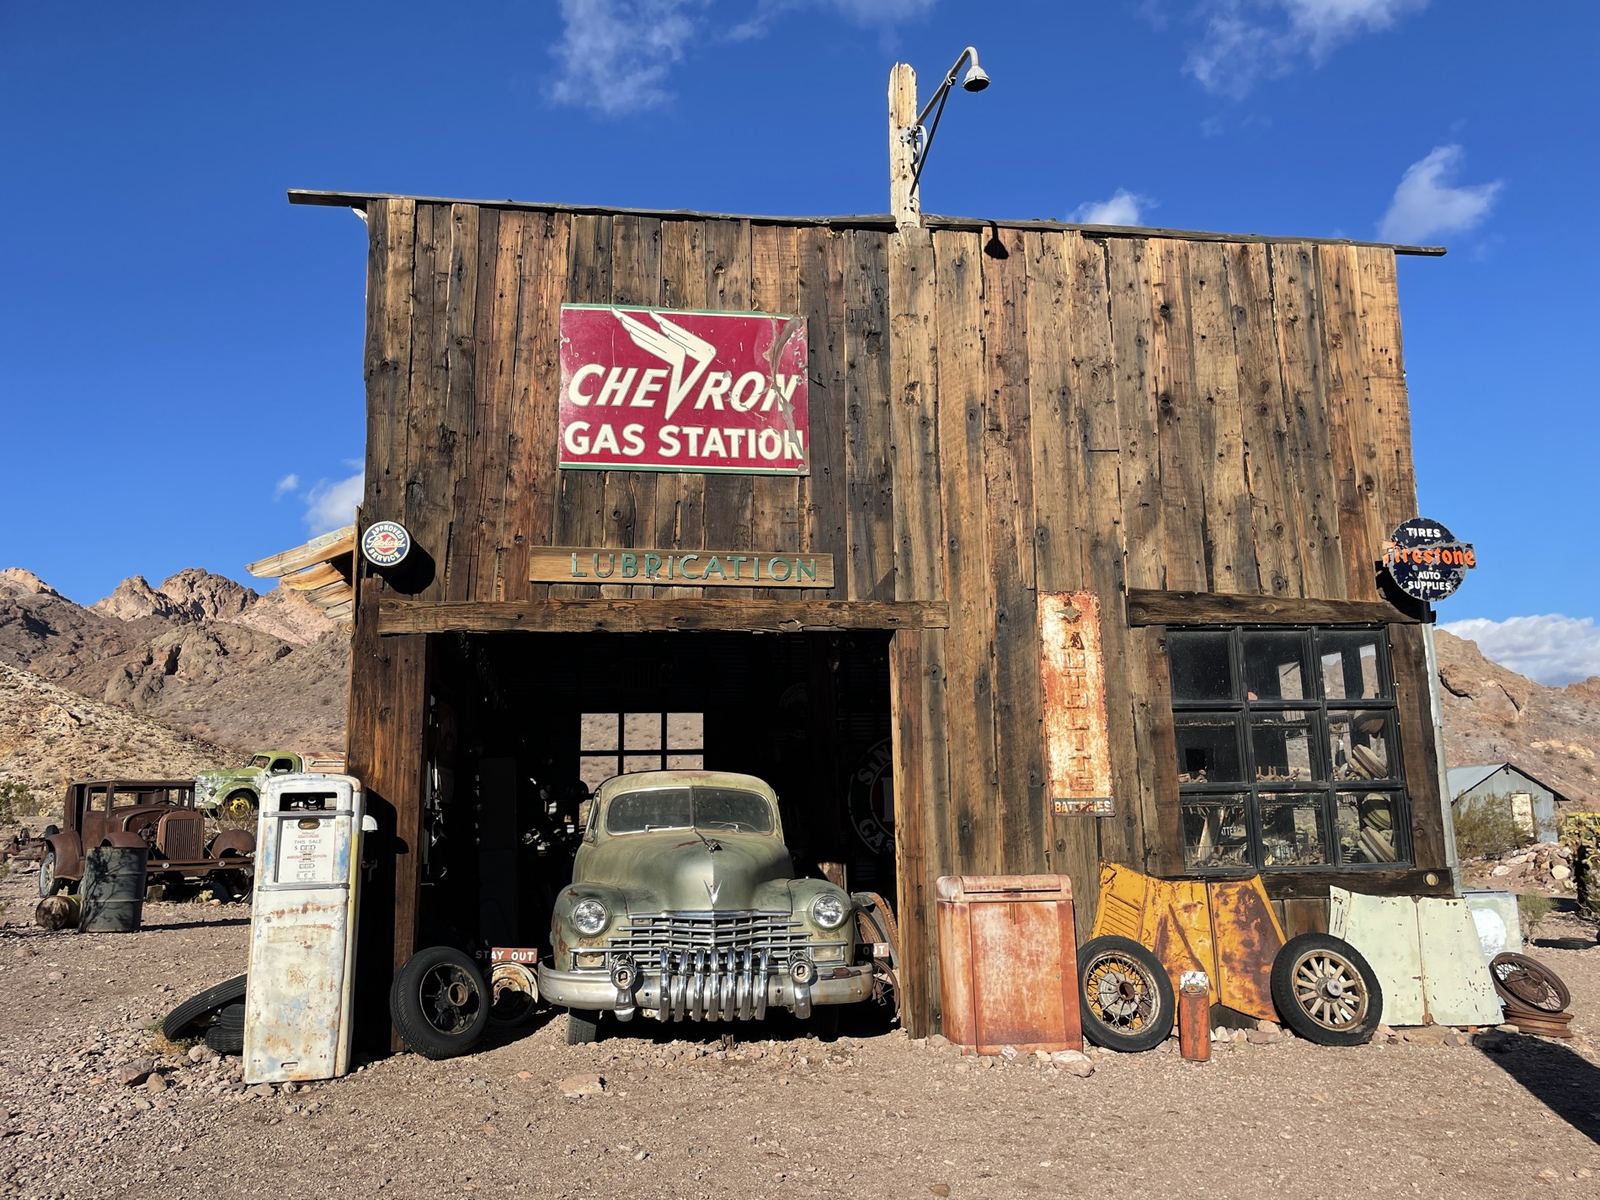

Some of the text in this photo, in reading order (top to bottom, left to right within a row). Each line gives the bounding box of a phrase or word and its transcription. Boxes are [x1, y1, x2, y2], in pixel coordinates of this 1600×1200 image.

[568, 363, 800, 421] CHEVRON
[563, 421, 803, 461] GAS STATION
[371, 524, 404, 539] APPROVED
[1406, 527, 1441, 538] TIRES
[368, 548, 401, 563] SERVICE
[571, 552, 817, 582] LUBRICATION
[1417, 571, 1440, 580] AUTO
[1407, 580, 1451, 591] SUPPLIES
[475, 950, 535, 962] STAY OUT
